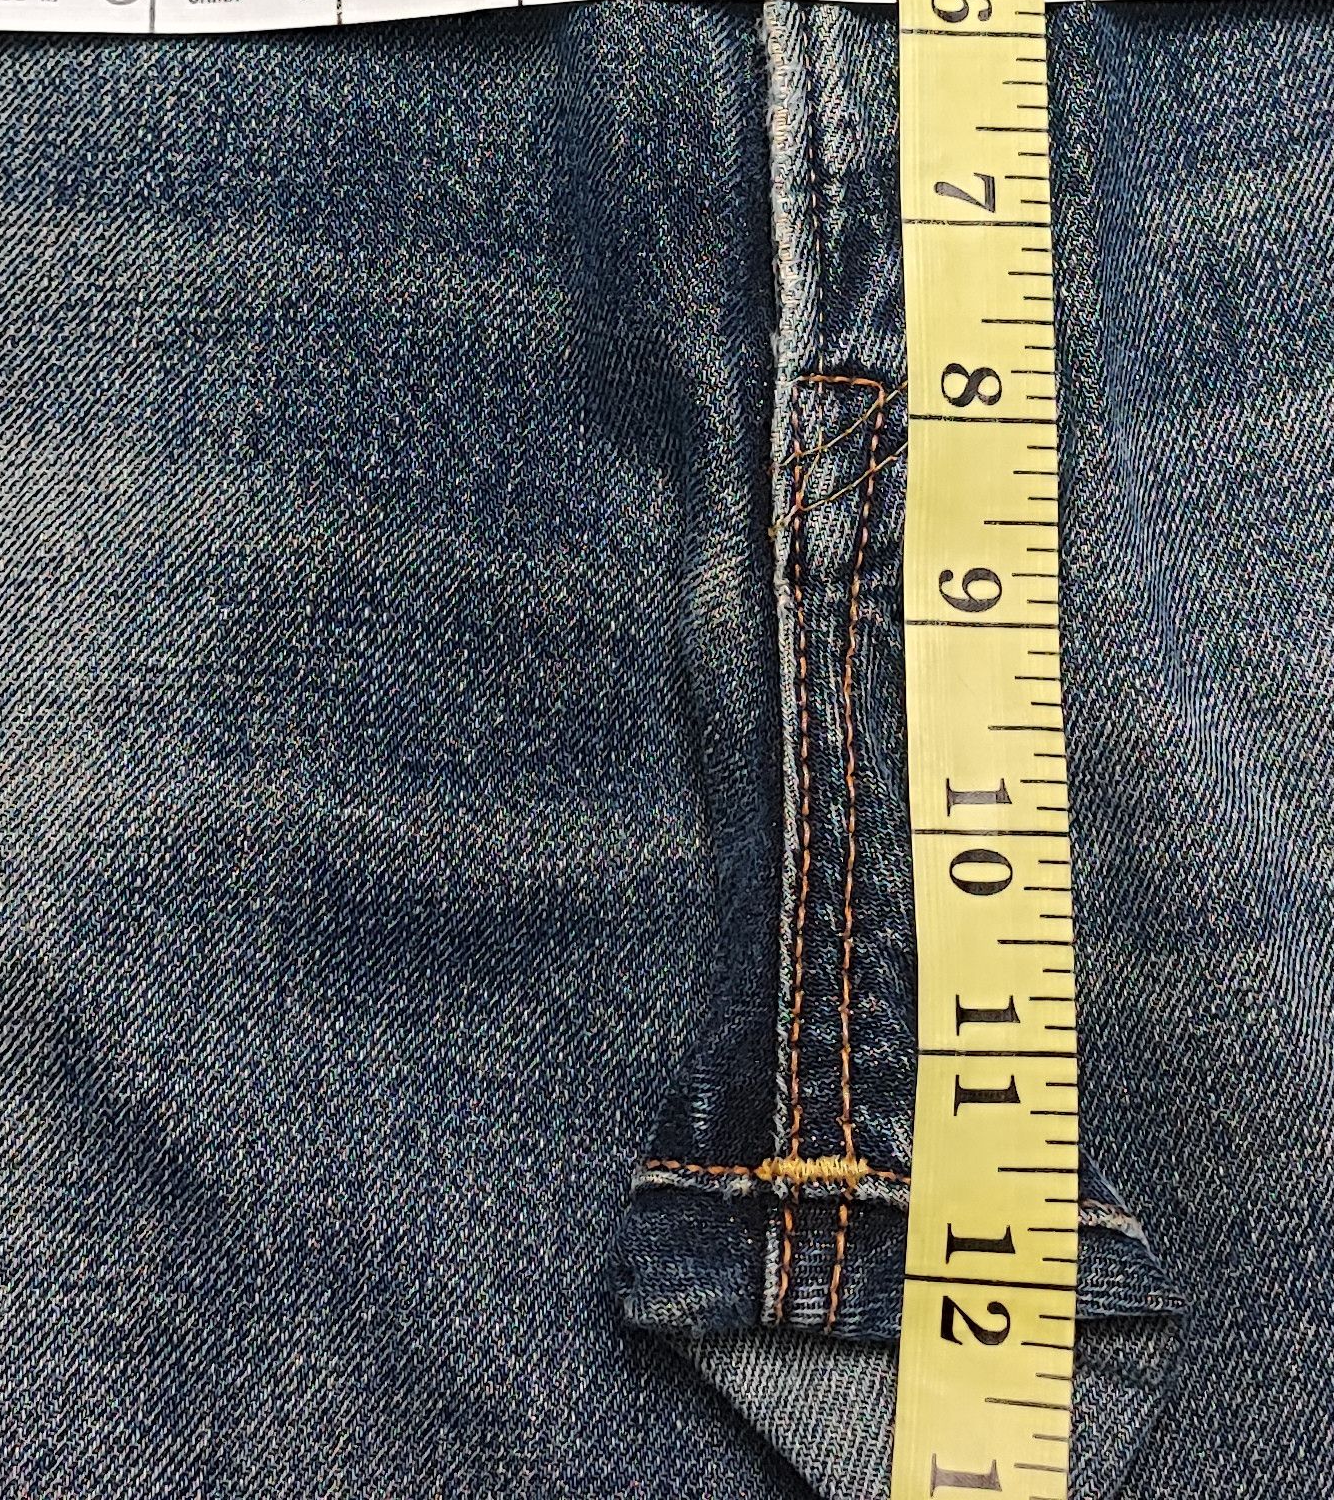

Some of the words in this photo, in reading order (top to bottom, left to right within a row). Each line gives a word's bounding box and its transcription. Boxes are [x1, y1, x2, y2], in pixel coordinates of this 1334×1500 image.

[933, 172, 996, 214] 7
[940, 362, 1003, 408] 8
[938, 567, 1003, 614] 9
[945, 777, 1013, 896] 10
[953, 994, 1021, 1117] 11
[940, 1222, 1016, 1346] 12
[929, 1452, 1003, 1499] 1
